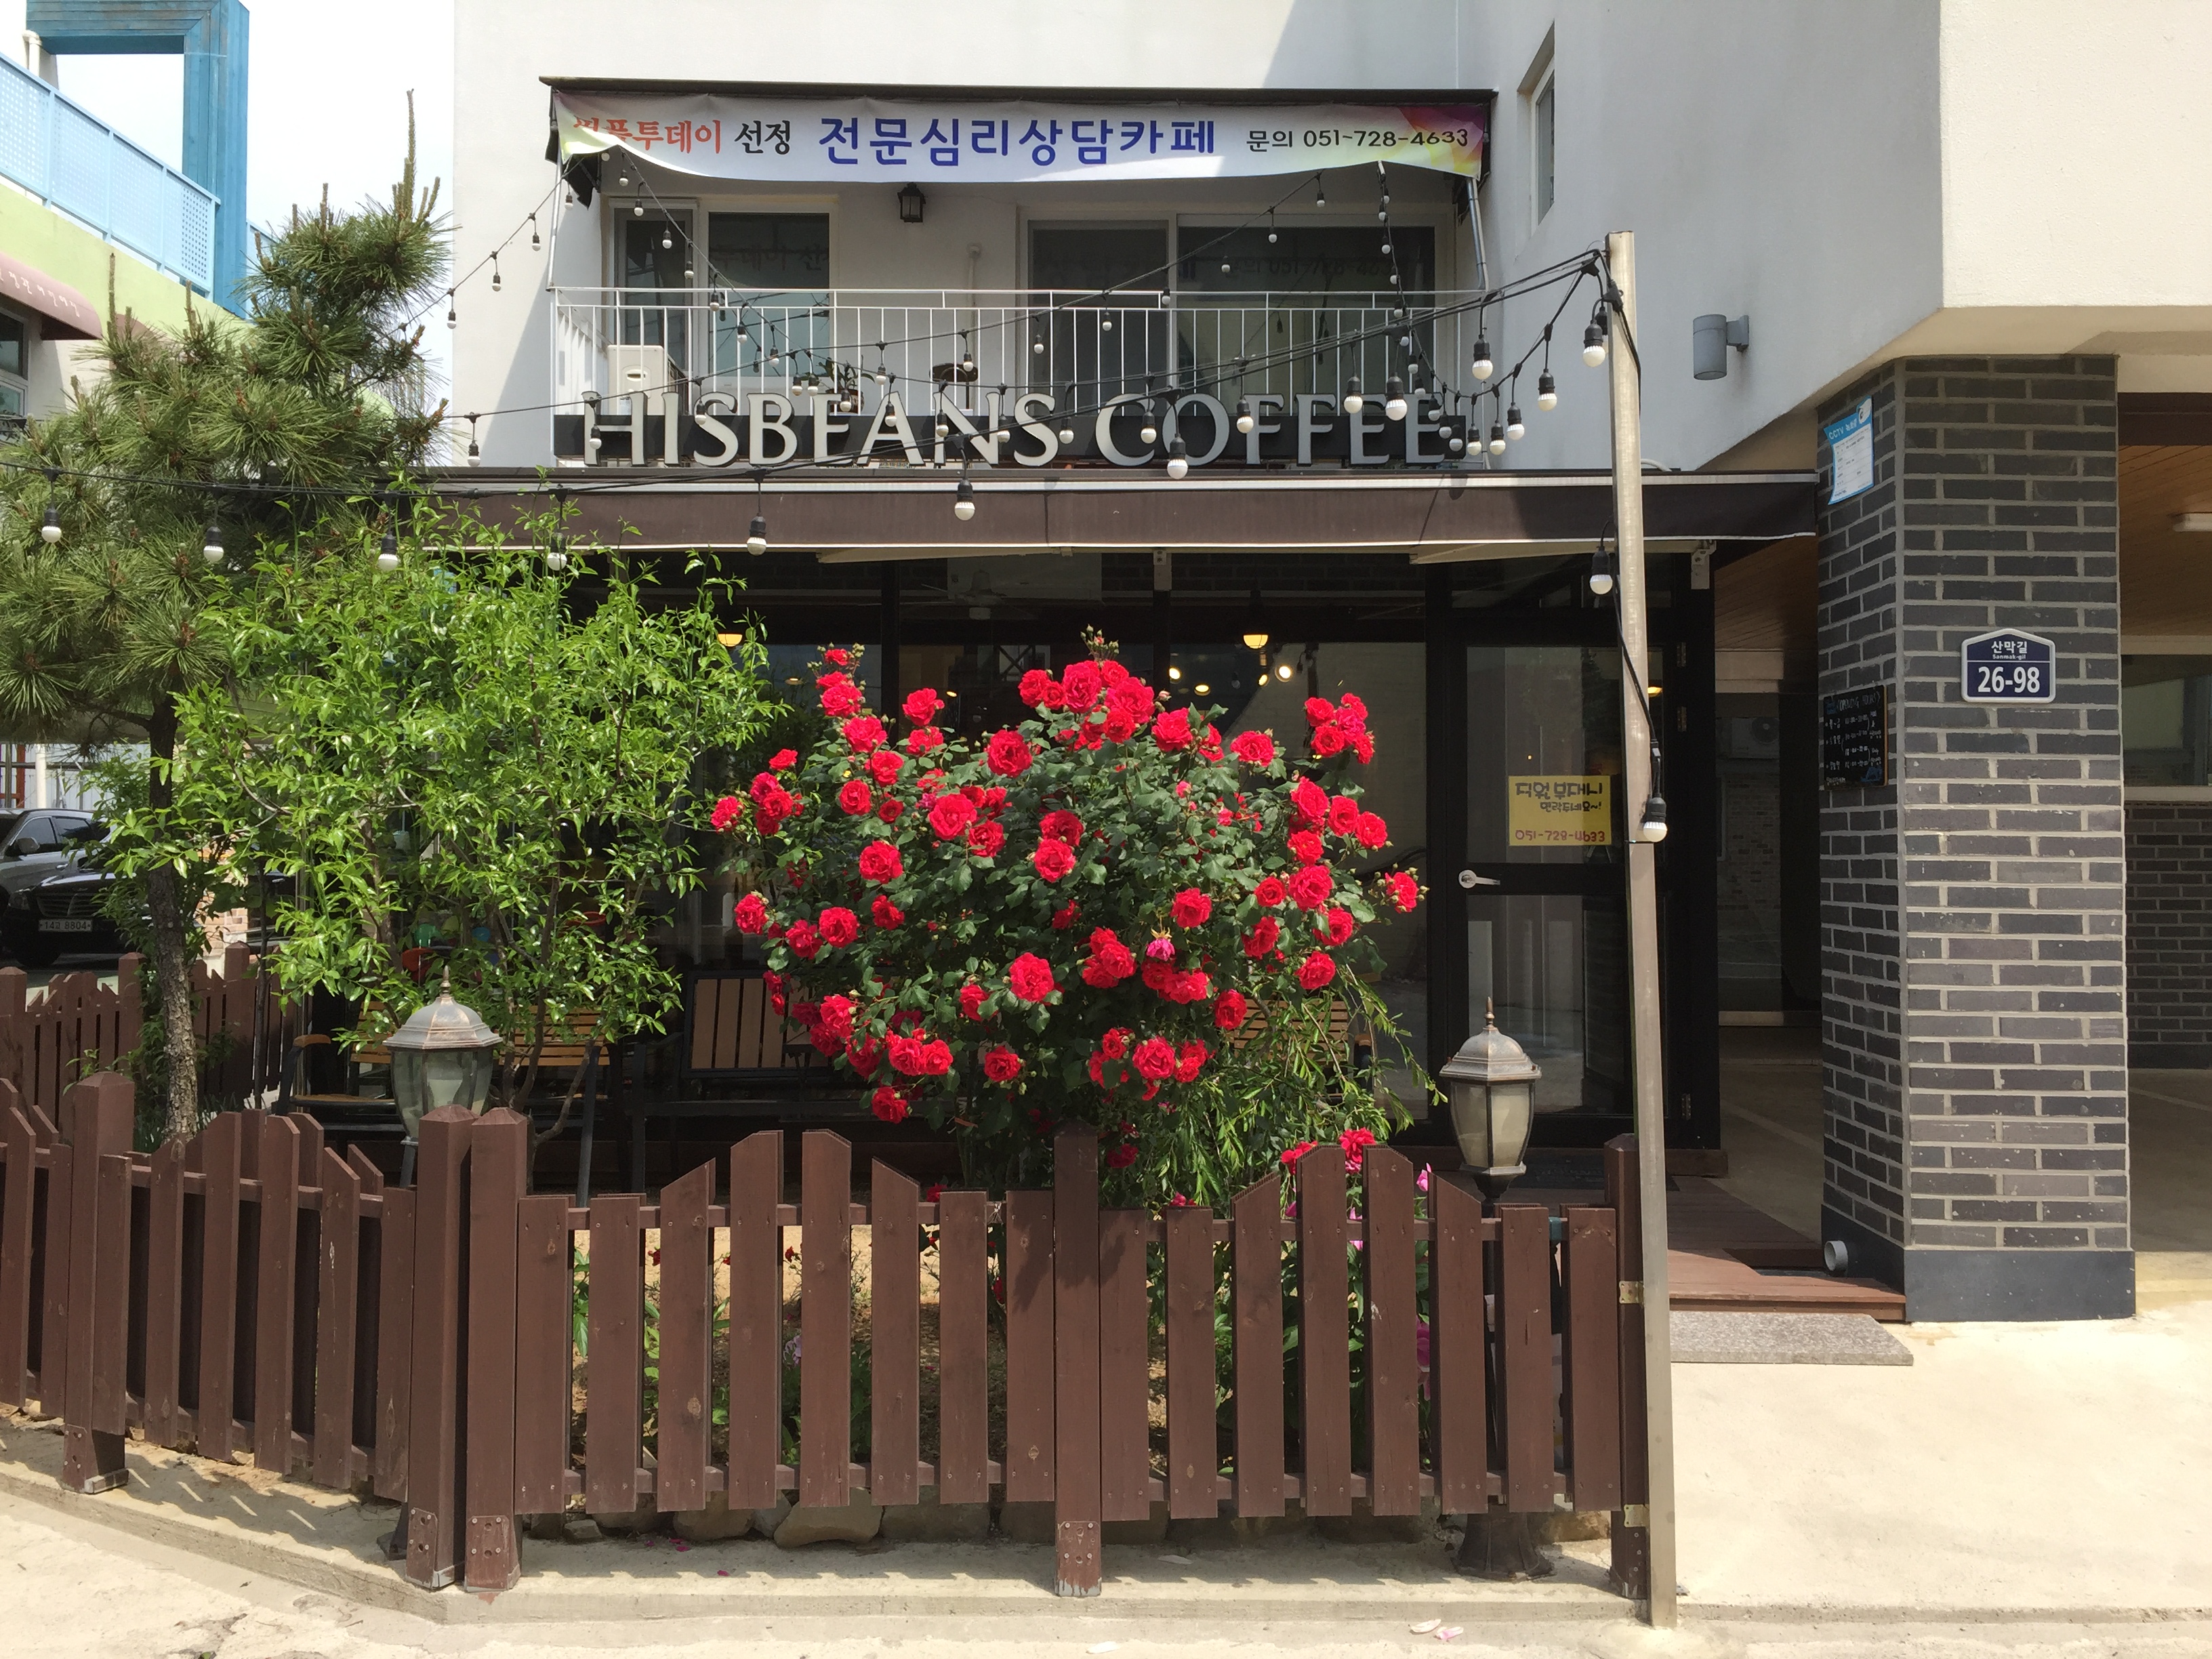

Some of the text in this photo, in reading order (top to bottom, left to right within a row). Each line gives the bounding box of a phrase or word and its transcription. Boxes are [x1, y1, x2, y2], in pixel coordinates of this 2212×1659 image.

[734, 119, 792, 155] 선정
[818, 117, 1215, 167] 전문심리상담카페
[1246, 129, 1294, 153] 문의
[1303, 127, 1469, 148] 051-728-4633
[581, 390, 1446, 468] HISBEANS COFFEE
[1828, 427, 1844, 441] CCTV
[1991, 641, 2028, 654] 산막길
[1978, 666, 2041, 693] 26-98
[1515, 830, 1605, 842] 051-728-4633
